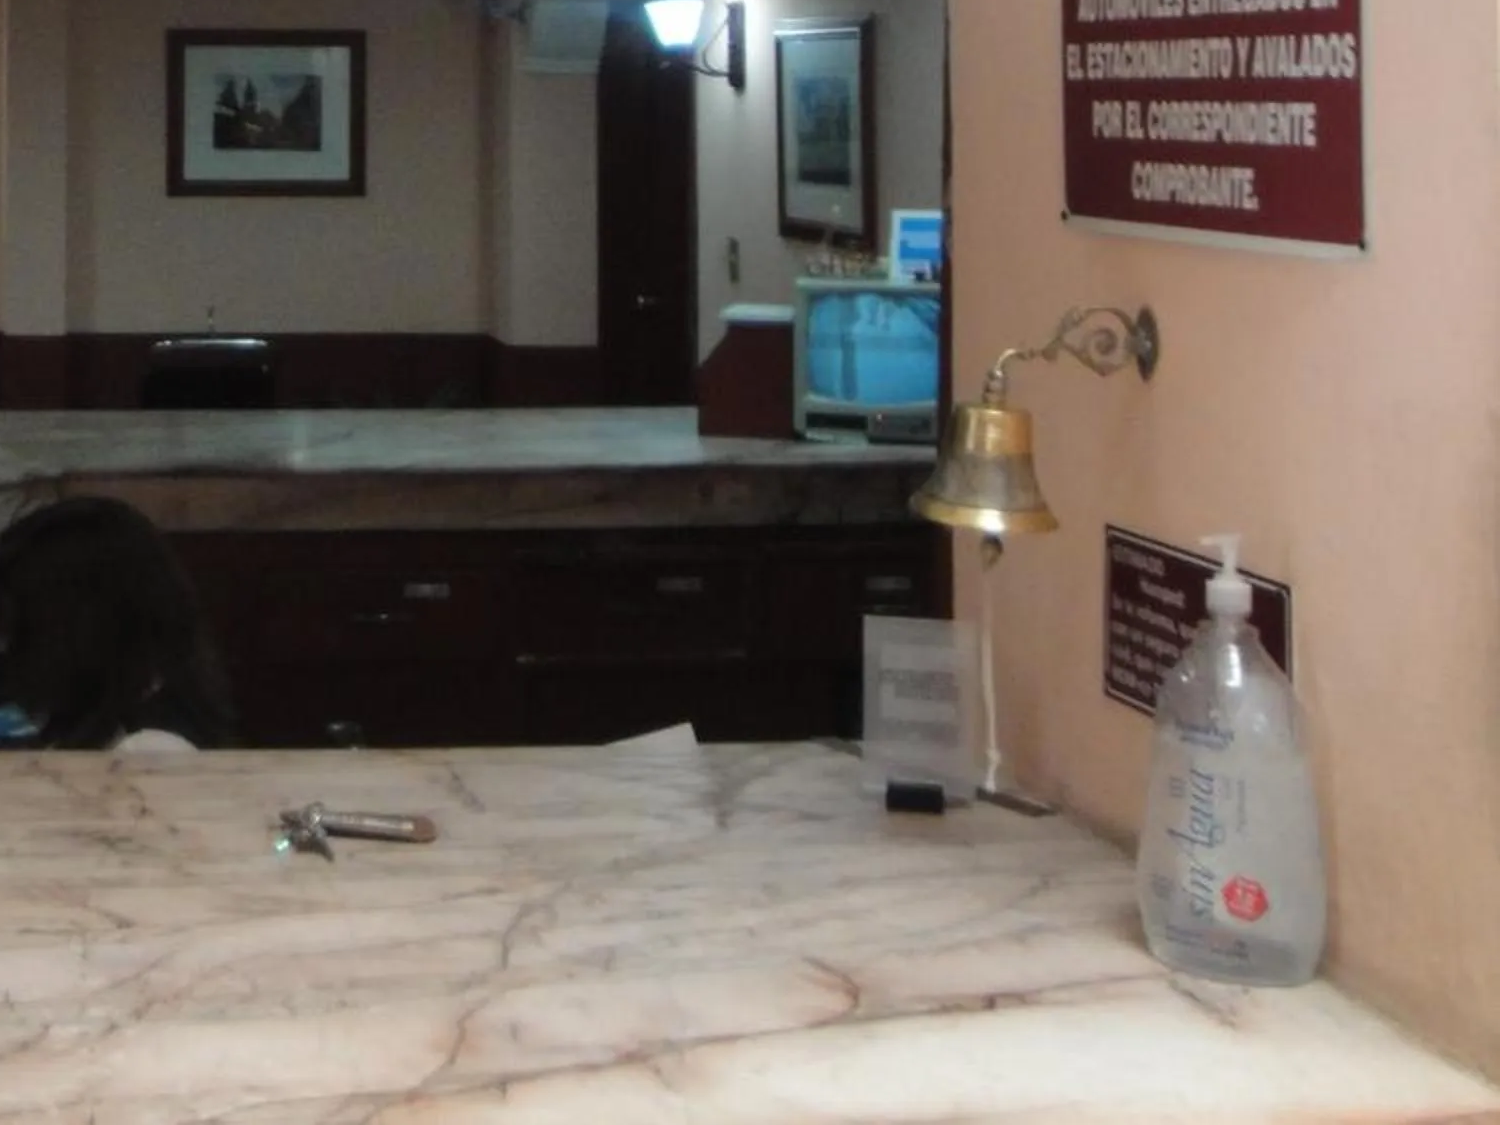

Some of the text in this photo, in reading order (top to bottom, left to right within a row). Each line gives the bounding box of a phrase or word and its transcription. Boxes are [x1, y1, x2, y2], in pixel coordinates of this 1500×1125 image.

[1067, 32, 1356, 80] EL ESTACIONAMIENTO Y AVALADOS
[1092, 100, 1317, 147] POR EL CORRESPONDIENTE
